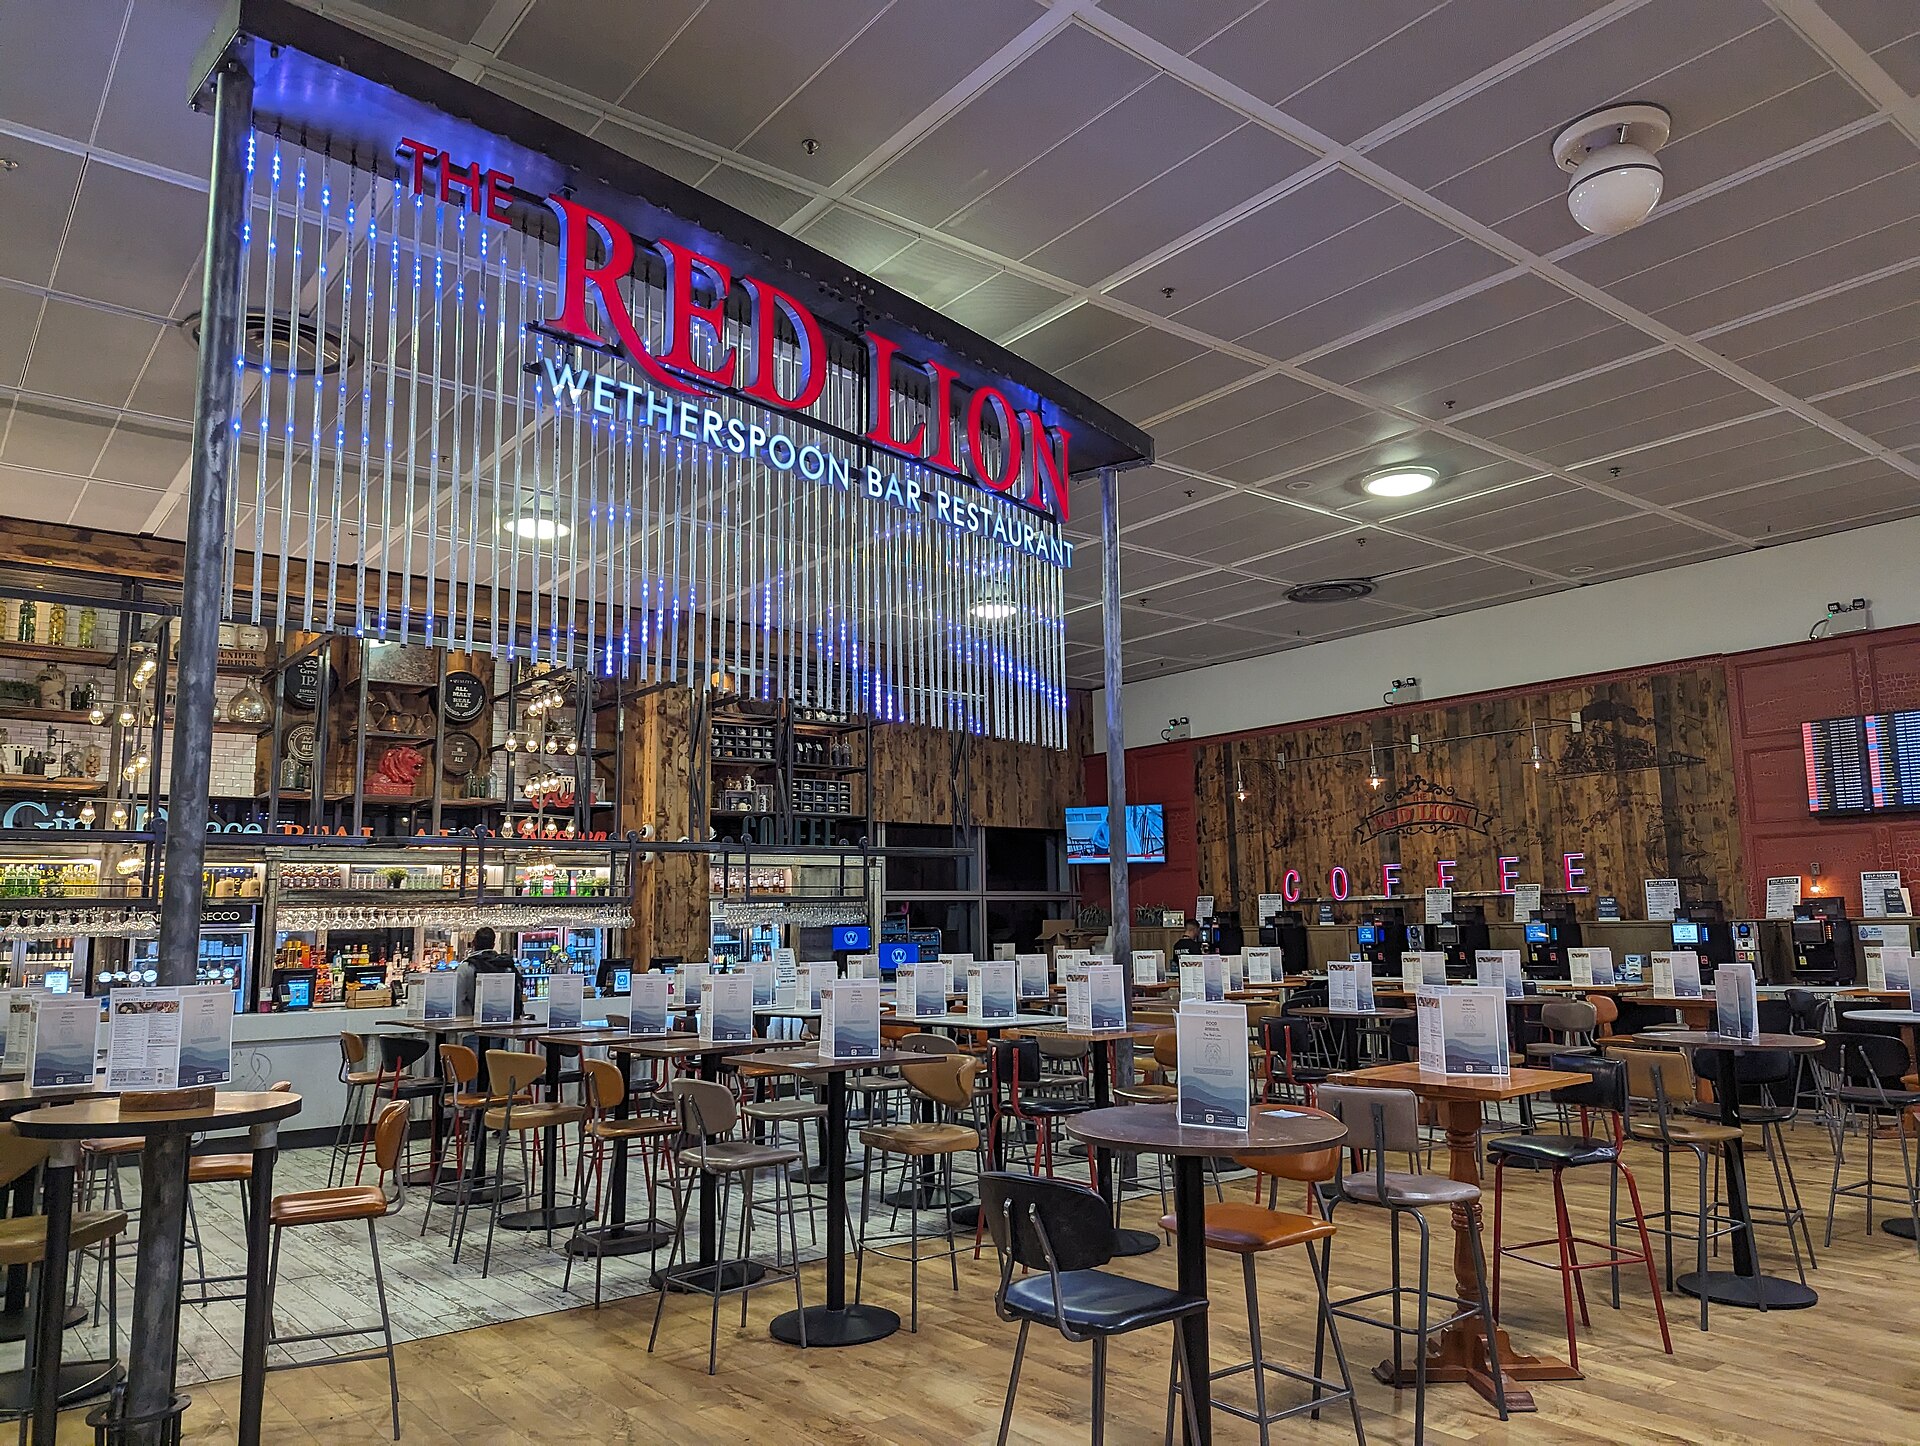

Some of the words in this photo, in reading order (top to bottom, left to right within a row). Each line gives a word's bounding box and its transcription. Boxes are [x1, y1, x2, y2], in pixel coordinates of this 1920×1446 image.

[401, 137, 515, 225] THE
[544, 194, 828, 410] RED
[865, 331, 1073, 523] LION
[543, 357, 850, 491] WETHERSPOON
[866, 465, 922, 513] BAR
[935, 487, 1076, 569] RESTAURANT
[1373, 806, 1413, 831] RED
[1418, 804, 1472, 826] LION
[1283, 852, 1590, 903] COFFEE
